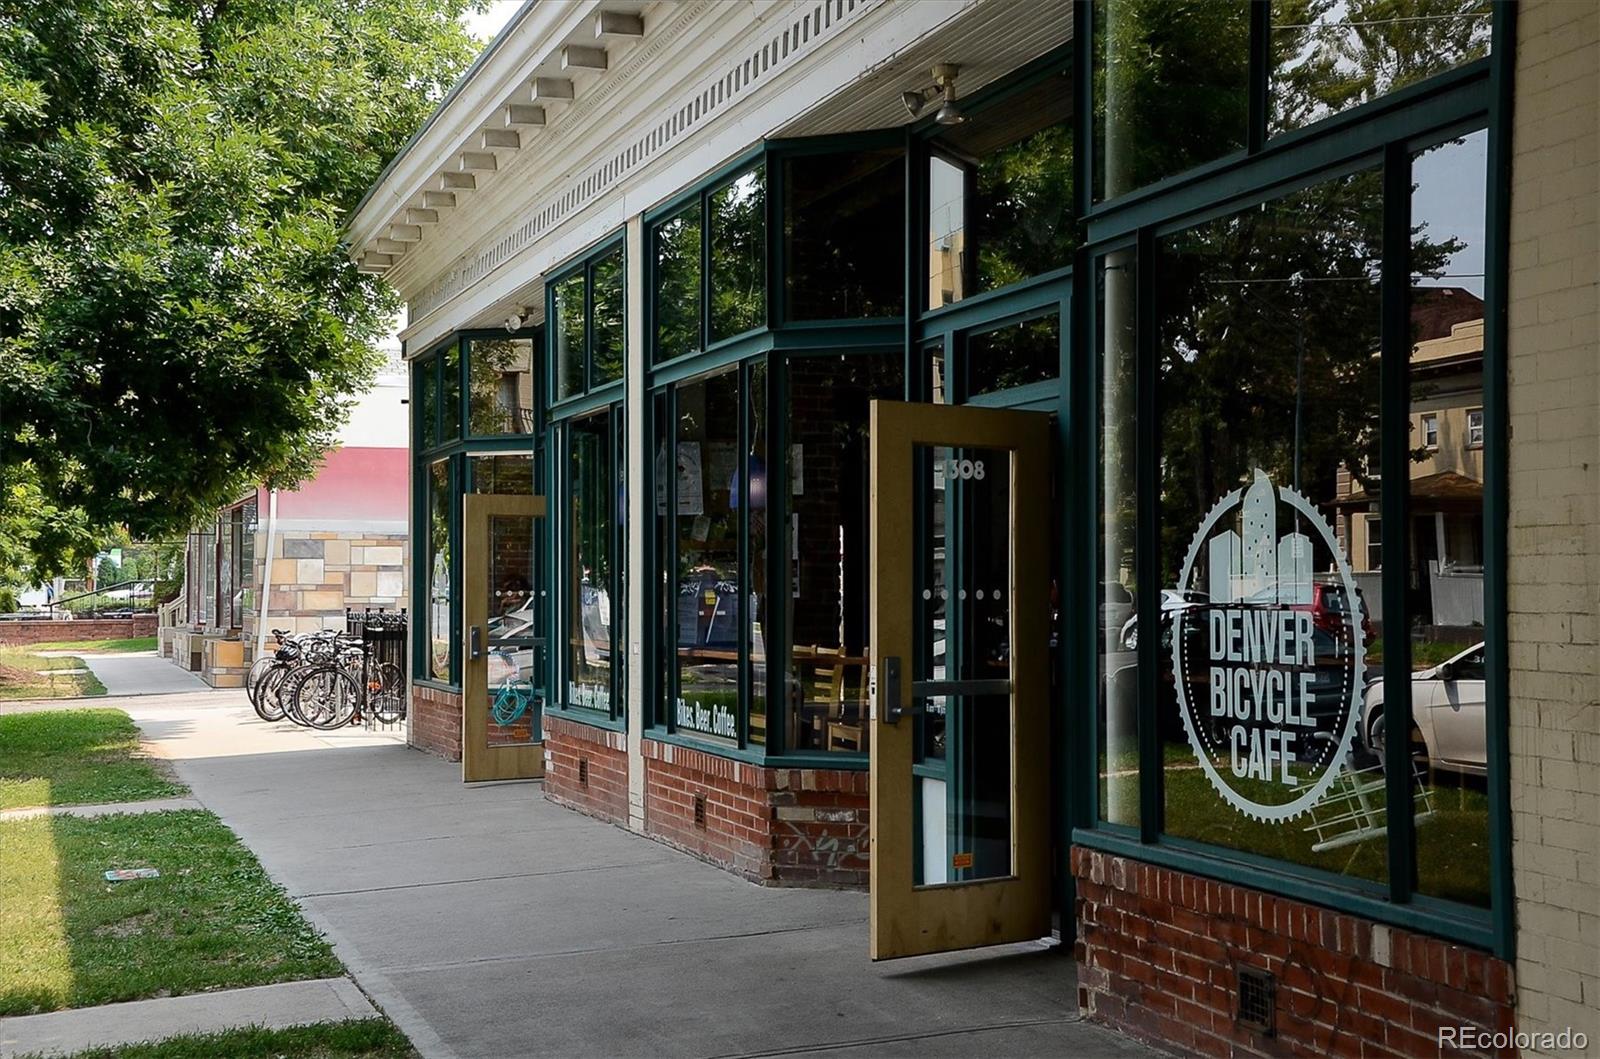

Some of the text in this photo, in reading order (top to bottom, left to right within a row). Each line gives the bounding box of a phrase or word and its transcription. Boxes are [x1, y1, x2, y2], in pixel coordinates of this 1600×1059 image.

[1210, 609, 1315, 666] DENVER
[1210, 667, 1317, 727] BICYCLE
[1231, 725, 1298, 785] CAFE
